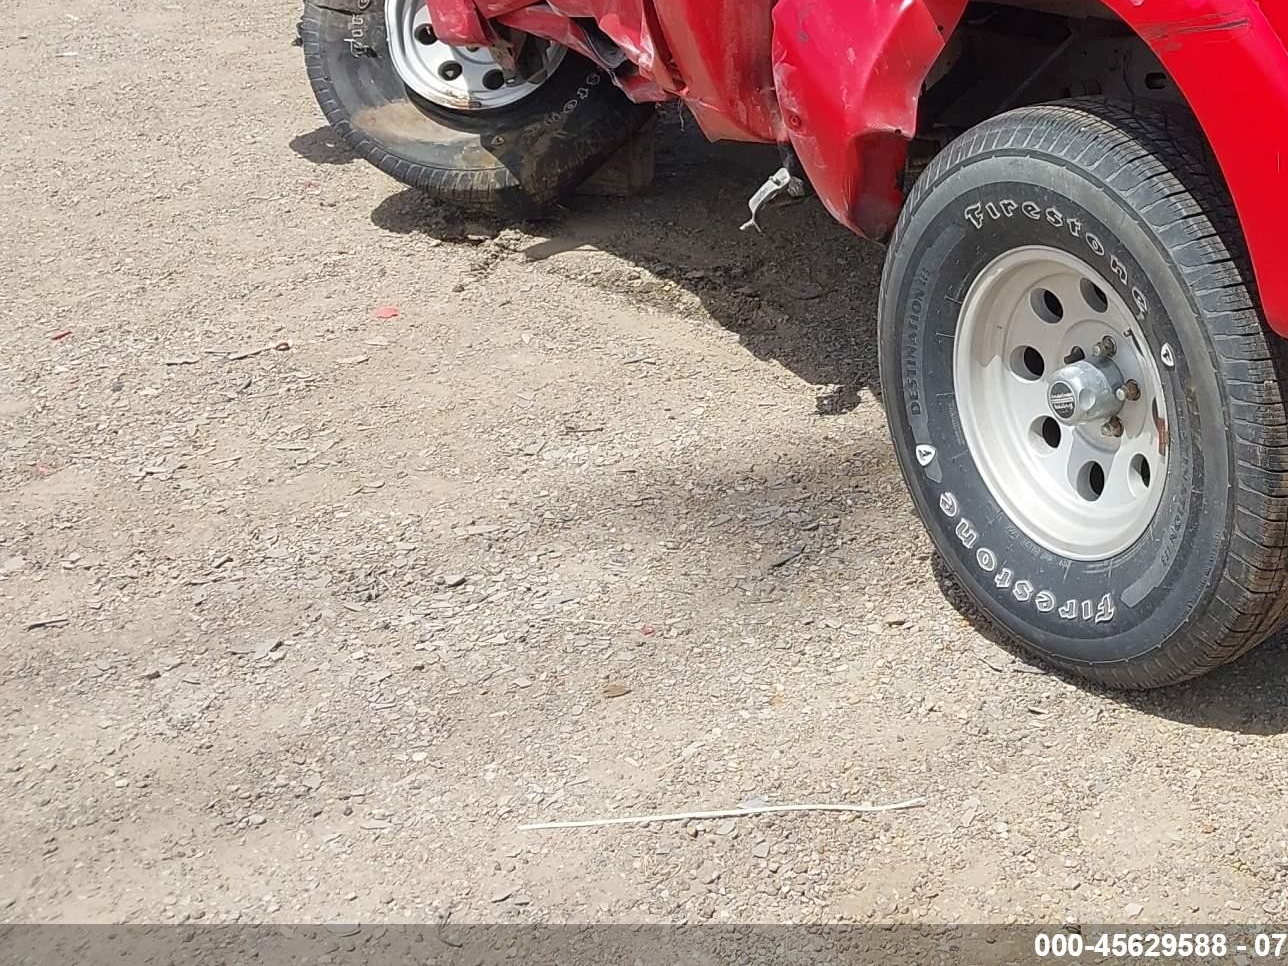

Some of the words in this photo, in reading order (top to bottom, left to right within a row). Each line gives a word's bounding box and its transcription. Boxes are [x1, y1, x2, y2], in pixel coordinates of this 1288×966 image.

[964, 198, 1149, 320] Firestone
[905, 286, 925, 416] DESTINATION
[939, 491, 1115, 624] Firestone
